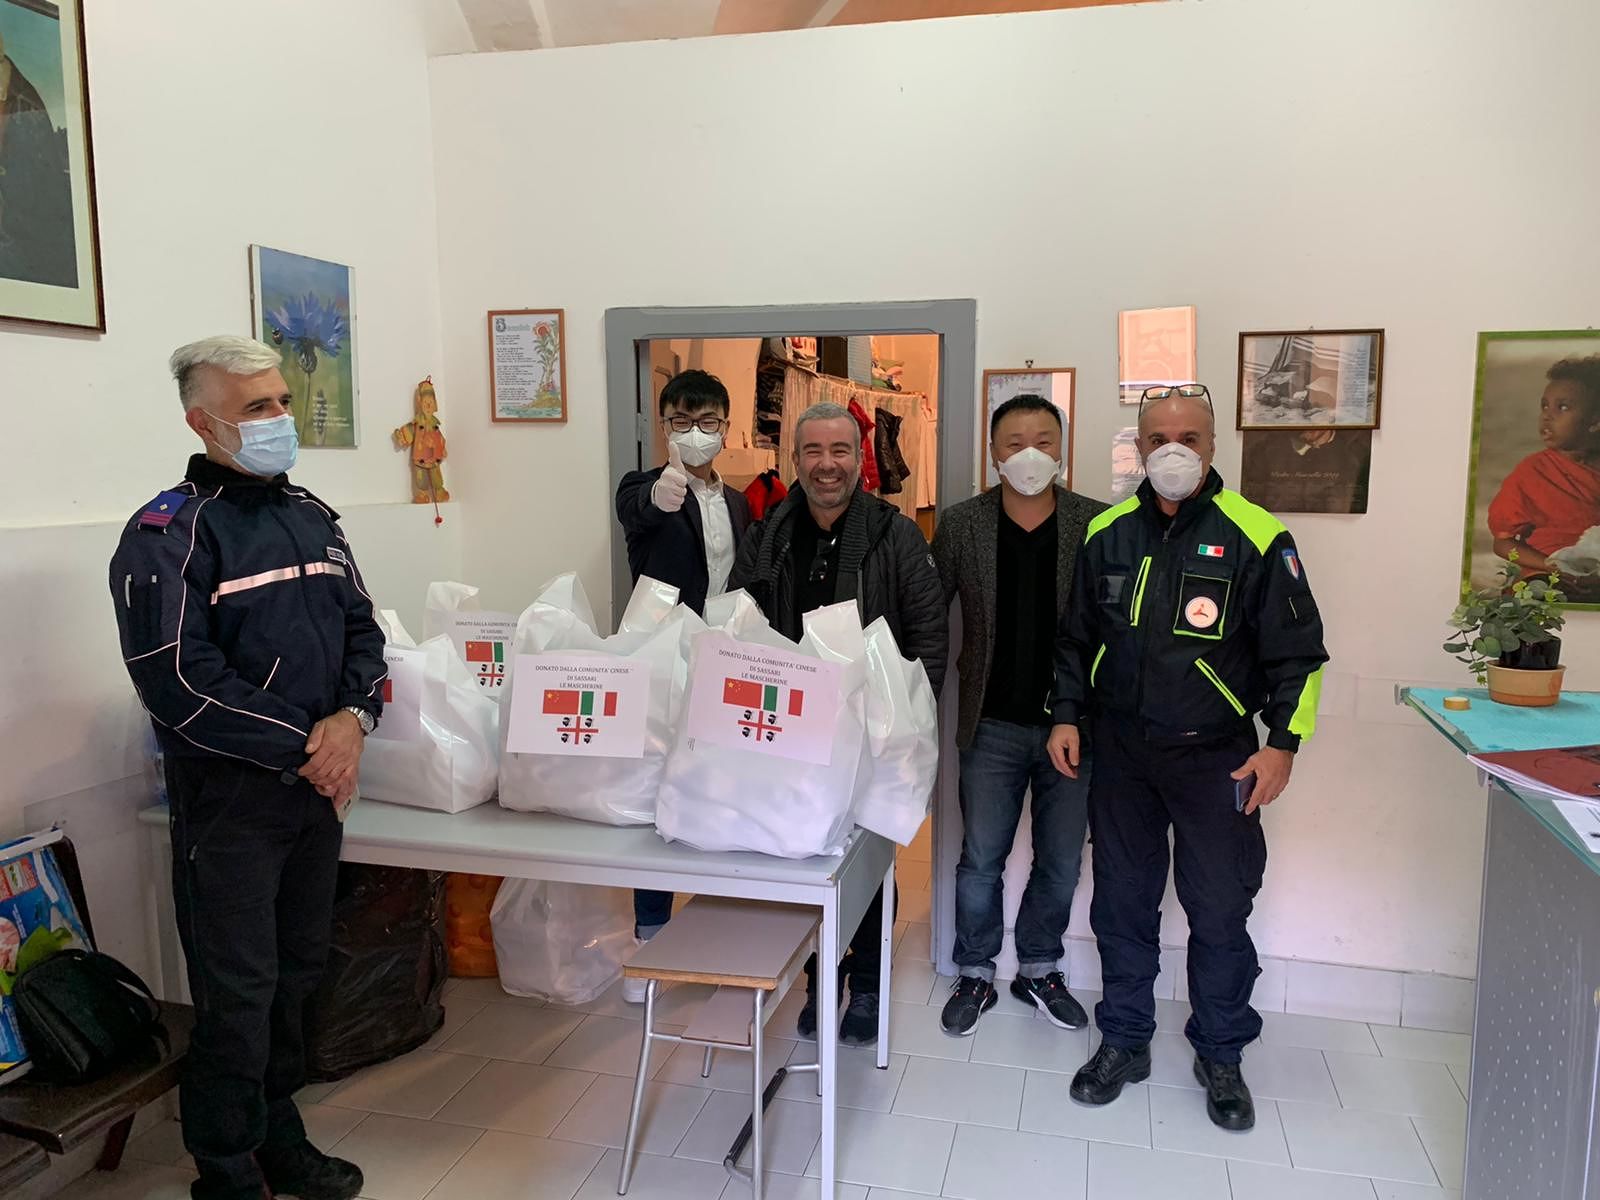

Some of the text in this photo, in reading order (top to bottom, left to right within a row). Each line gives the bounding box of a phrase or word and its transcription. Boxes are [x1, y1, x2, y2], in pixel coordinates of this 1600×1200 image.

[718, 650, 817, 673] DONATO DALLA COMUNITA' CINESE
[757, 667, 781, 676] SASSARI
[750, 674, 788, 686] MASCHERINE
